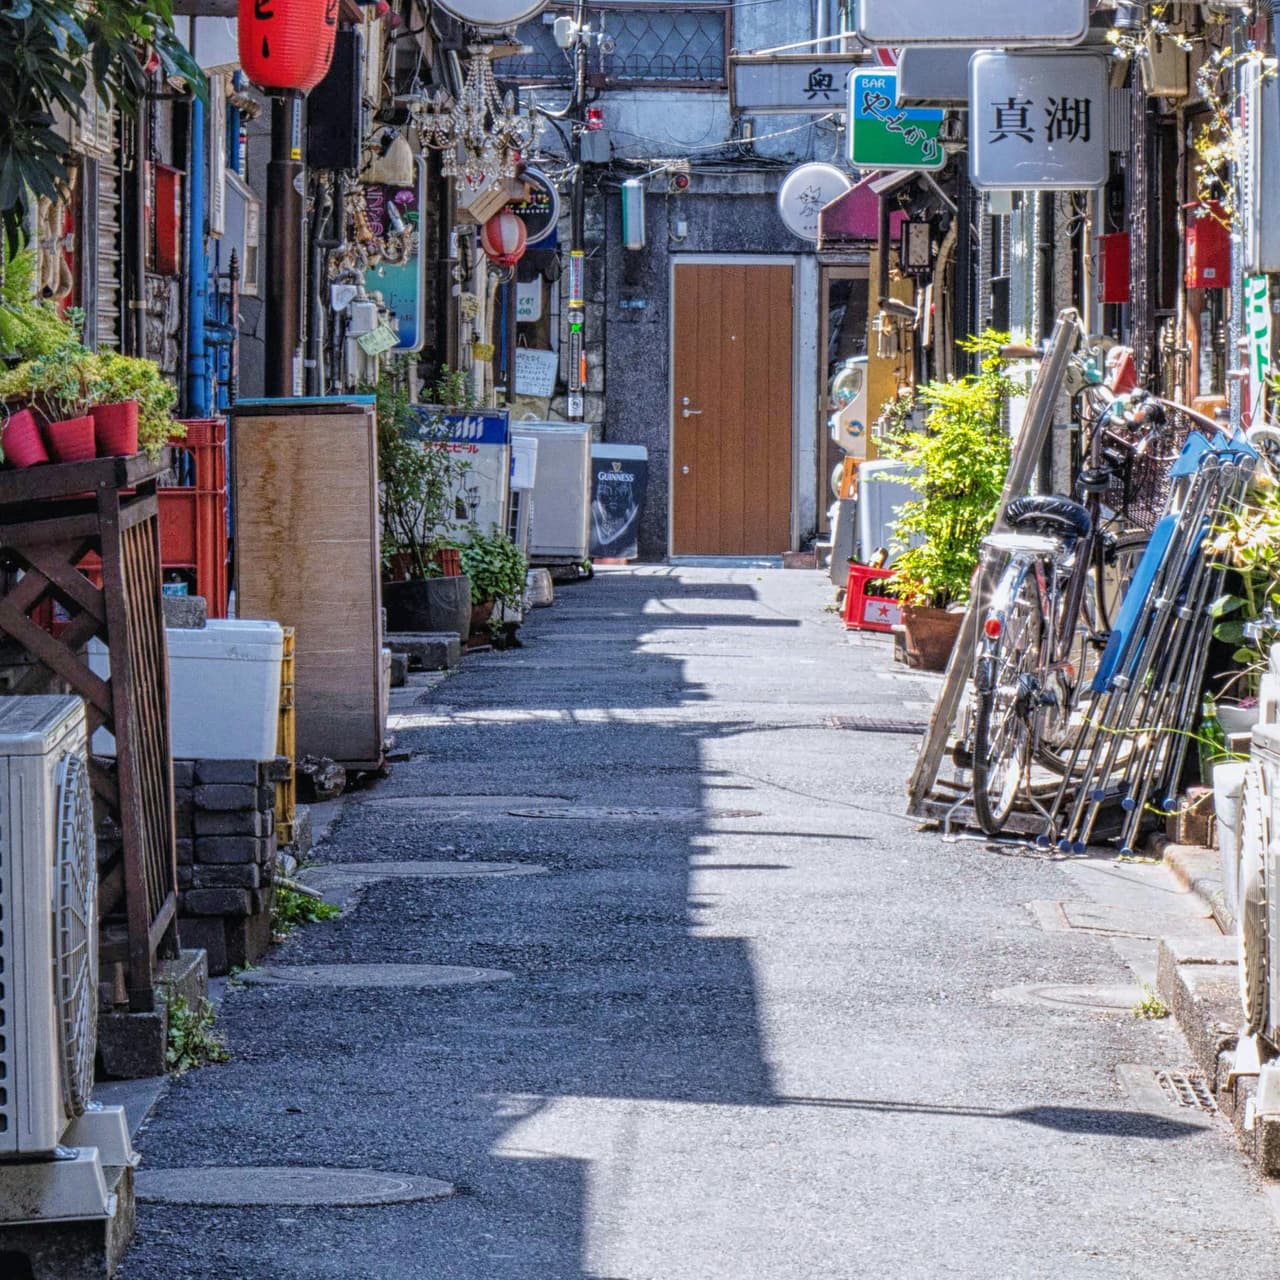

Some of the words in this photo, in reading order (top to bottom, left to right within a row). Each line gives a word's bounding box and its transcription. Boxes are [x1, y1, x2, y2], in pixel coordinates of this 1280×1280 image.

[861, 78, 886, 89] BAR
[988, 96, 1093, 145] 真湖
[597, 471, 635, 482] GUINNESS
